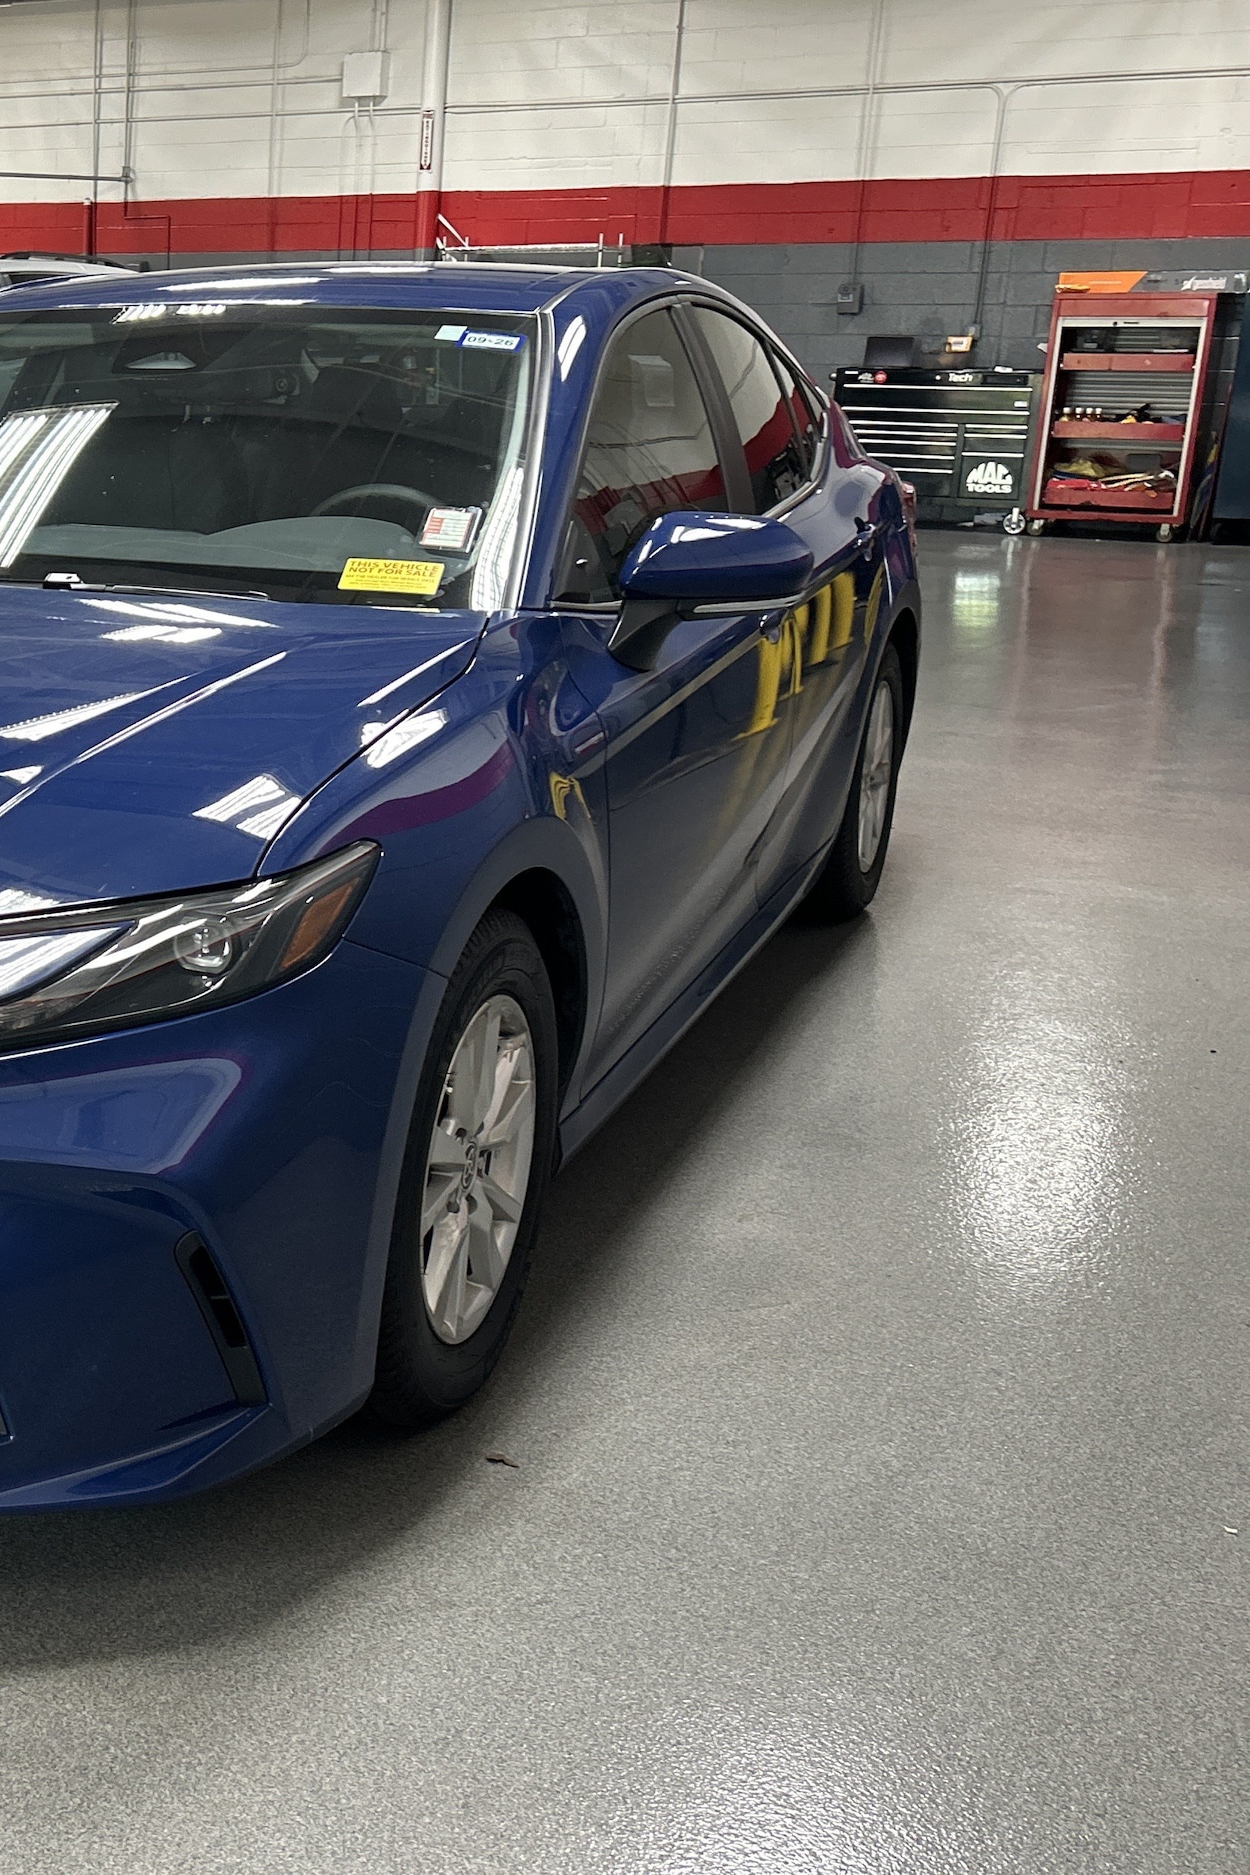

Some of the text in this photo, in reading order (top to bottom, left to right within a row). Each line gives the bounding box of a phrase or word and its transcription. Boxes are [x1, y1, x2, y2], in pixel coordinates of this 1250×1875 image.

[467, 336, 514, 346] 09-26
[948, 373, 973, 382] Tech
[966, 461, 1012, 485] MAC
[966, 483, 1012, 493] TOOLS
[383, 562, 439, 572] VEHICLE
[405, 569, 437, 578] SALE
